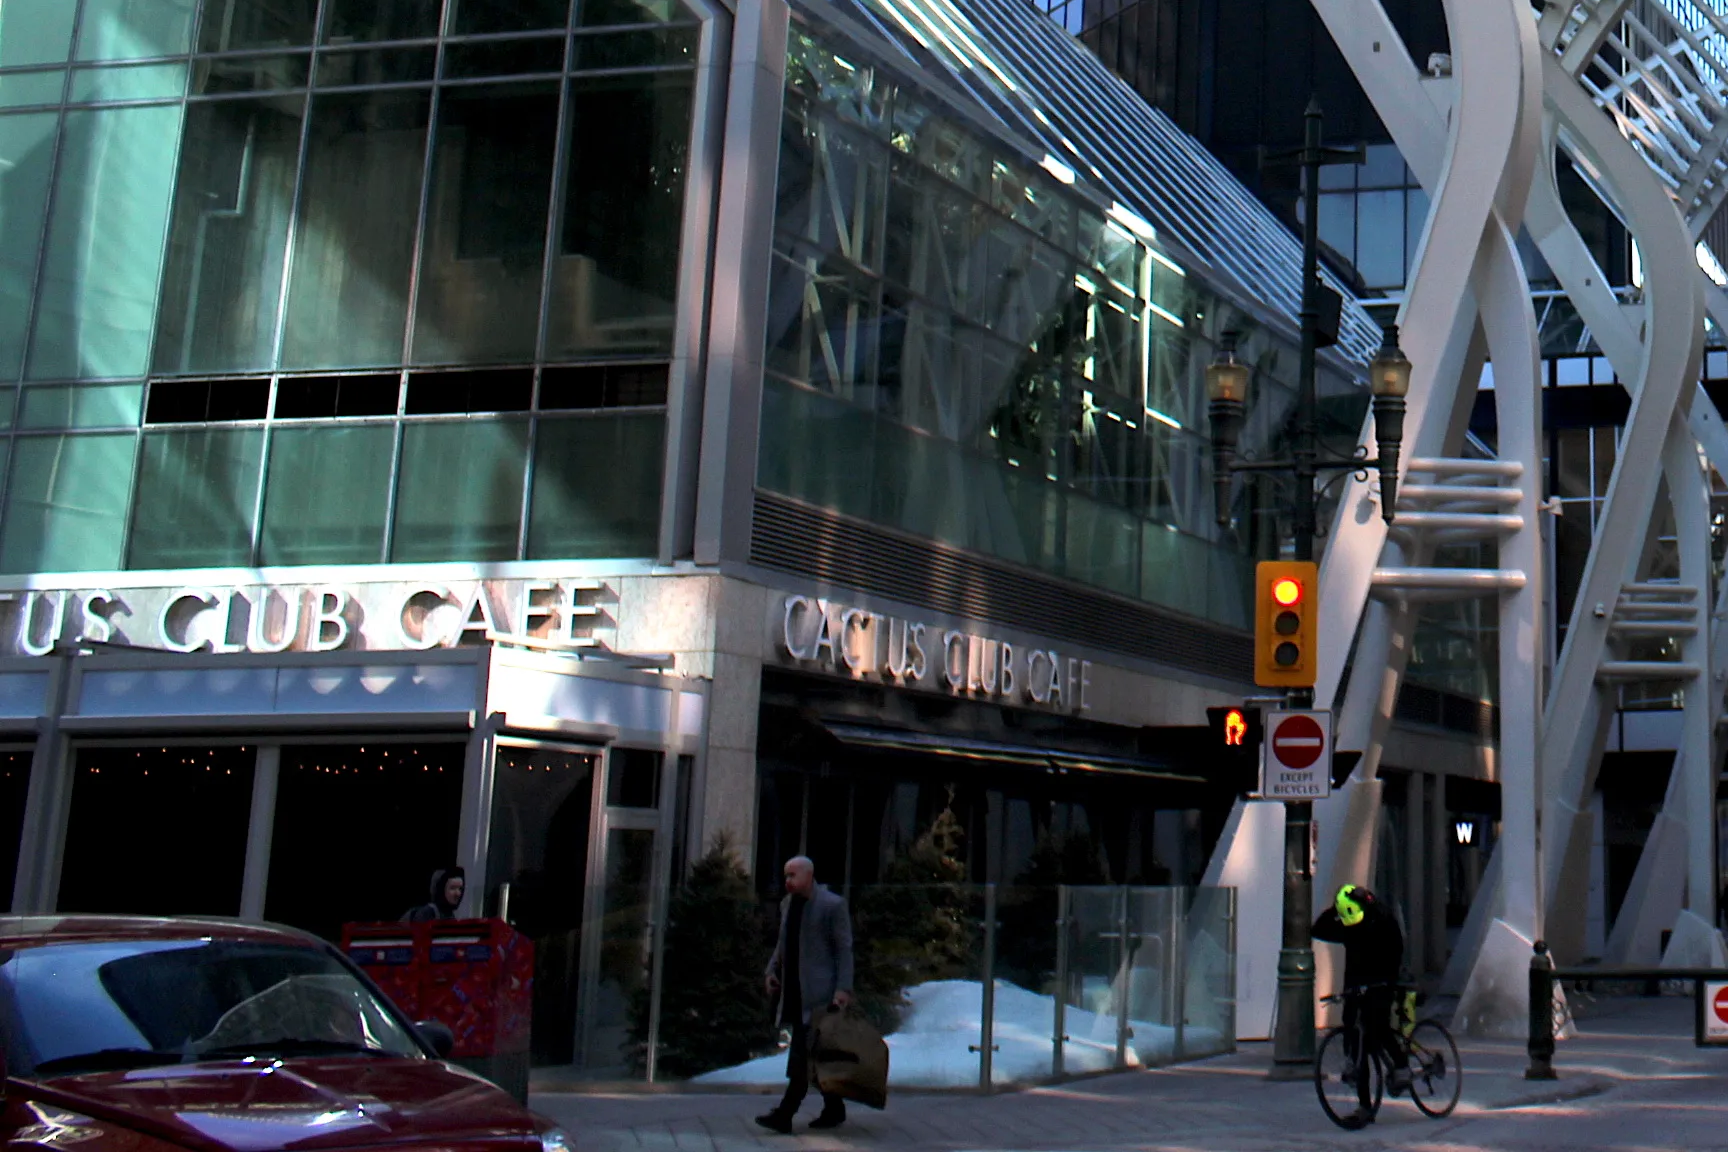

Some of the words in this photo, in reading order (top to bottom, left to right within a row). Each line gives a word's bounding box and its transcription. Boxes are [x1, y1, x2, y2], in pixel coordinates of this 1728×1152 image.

[0, 589, 112, 656] US
[158, 586, 349, 653] CLUB
[400, 579, 602, 649] CAFE
[784, 595, 926, 681] CACTUS
[943, 629, 1015, 694] CLUB
[1026, 649, 1093, 711] CAFE
[1280, 771, 1313, 783] EXCEPT
[1274, 783, 1319, 794] BICYCLES
[1456, 822, 1473, 844] W
